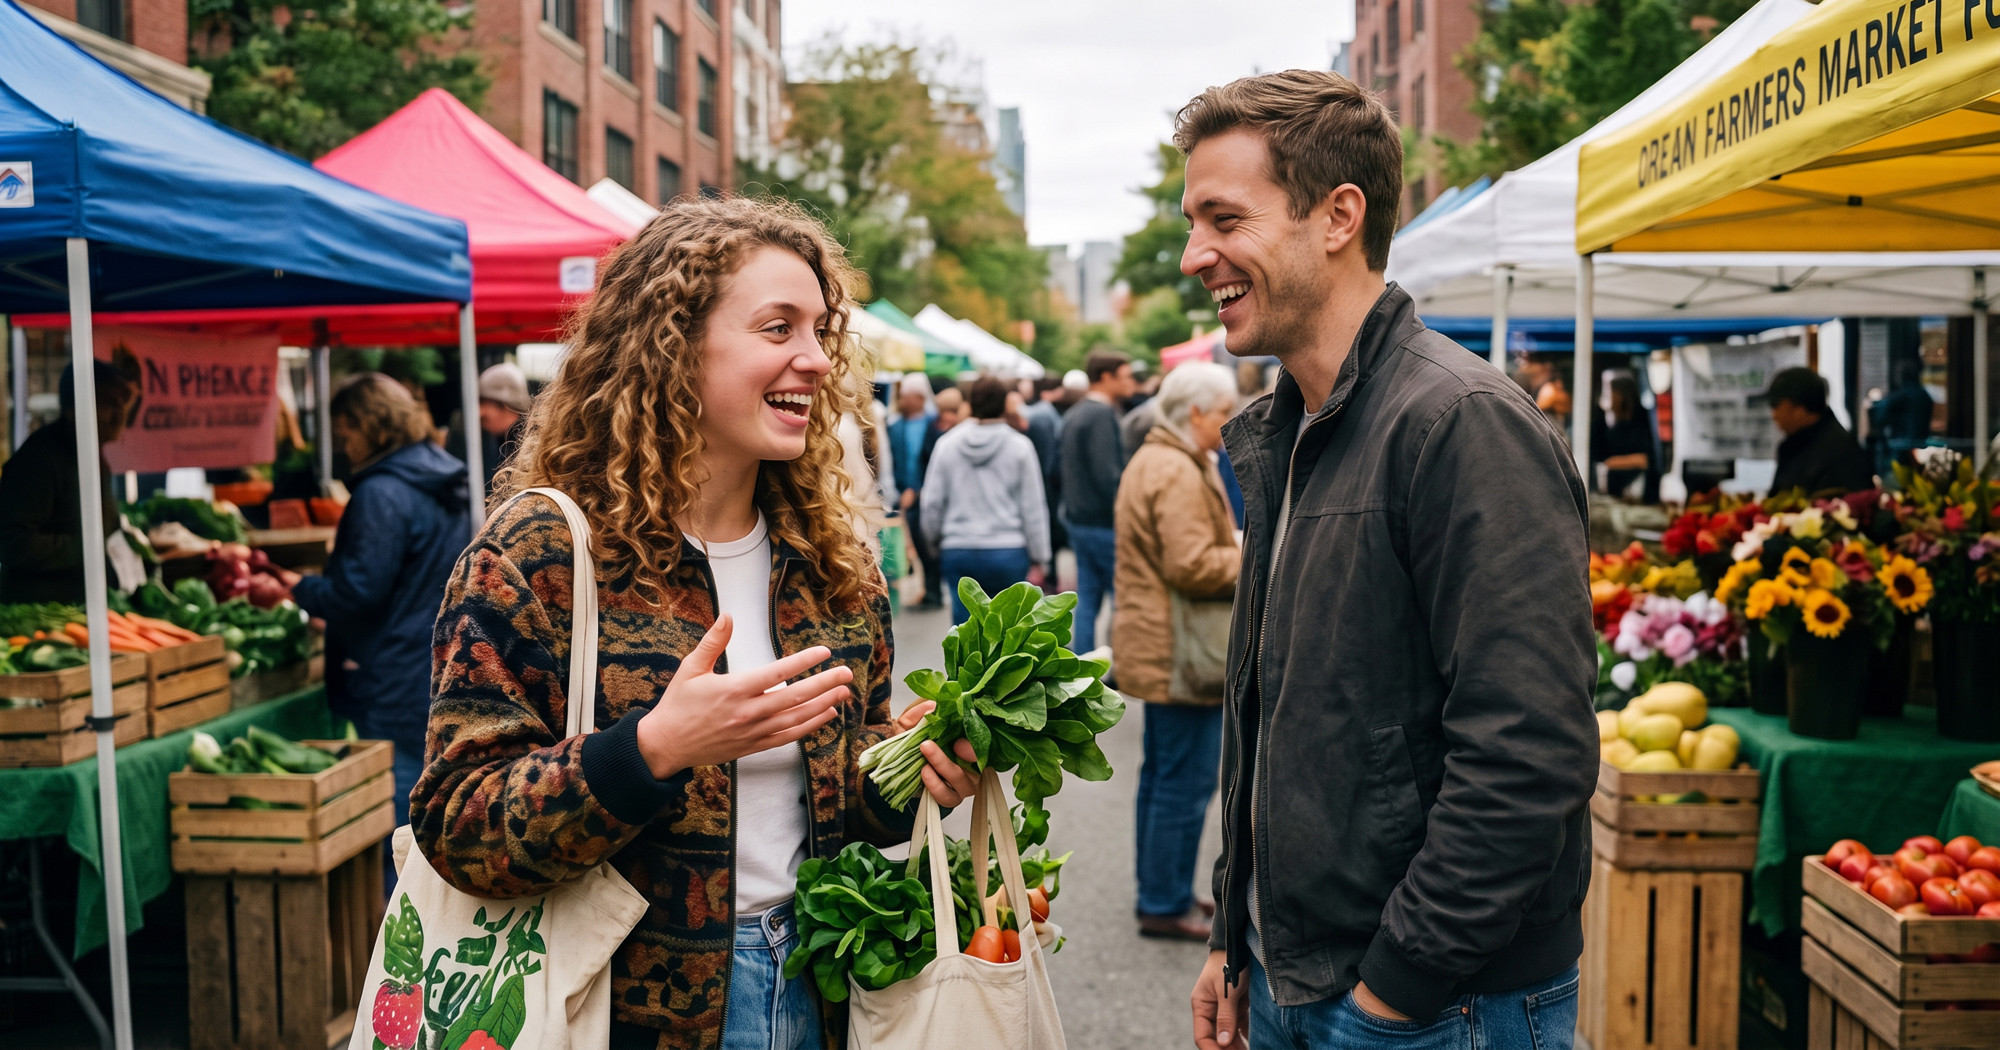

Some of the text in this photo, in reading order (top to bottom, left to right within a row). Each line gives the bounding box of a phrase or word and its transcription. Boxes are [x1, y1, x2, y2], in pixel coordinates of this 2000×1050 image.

[1638, 116, 1697, 188] OREAN
[1704, 56, 1806, 158] FARMERS
[1818, 0, 1943, 106] MARKET
